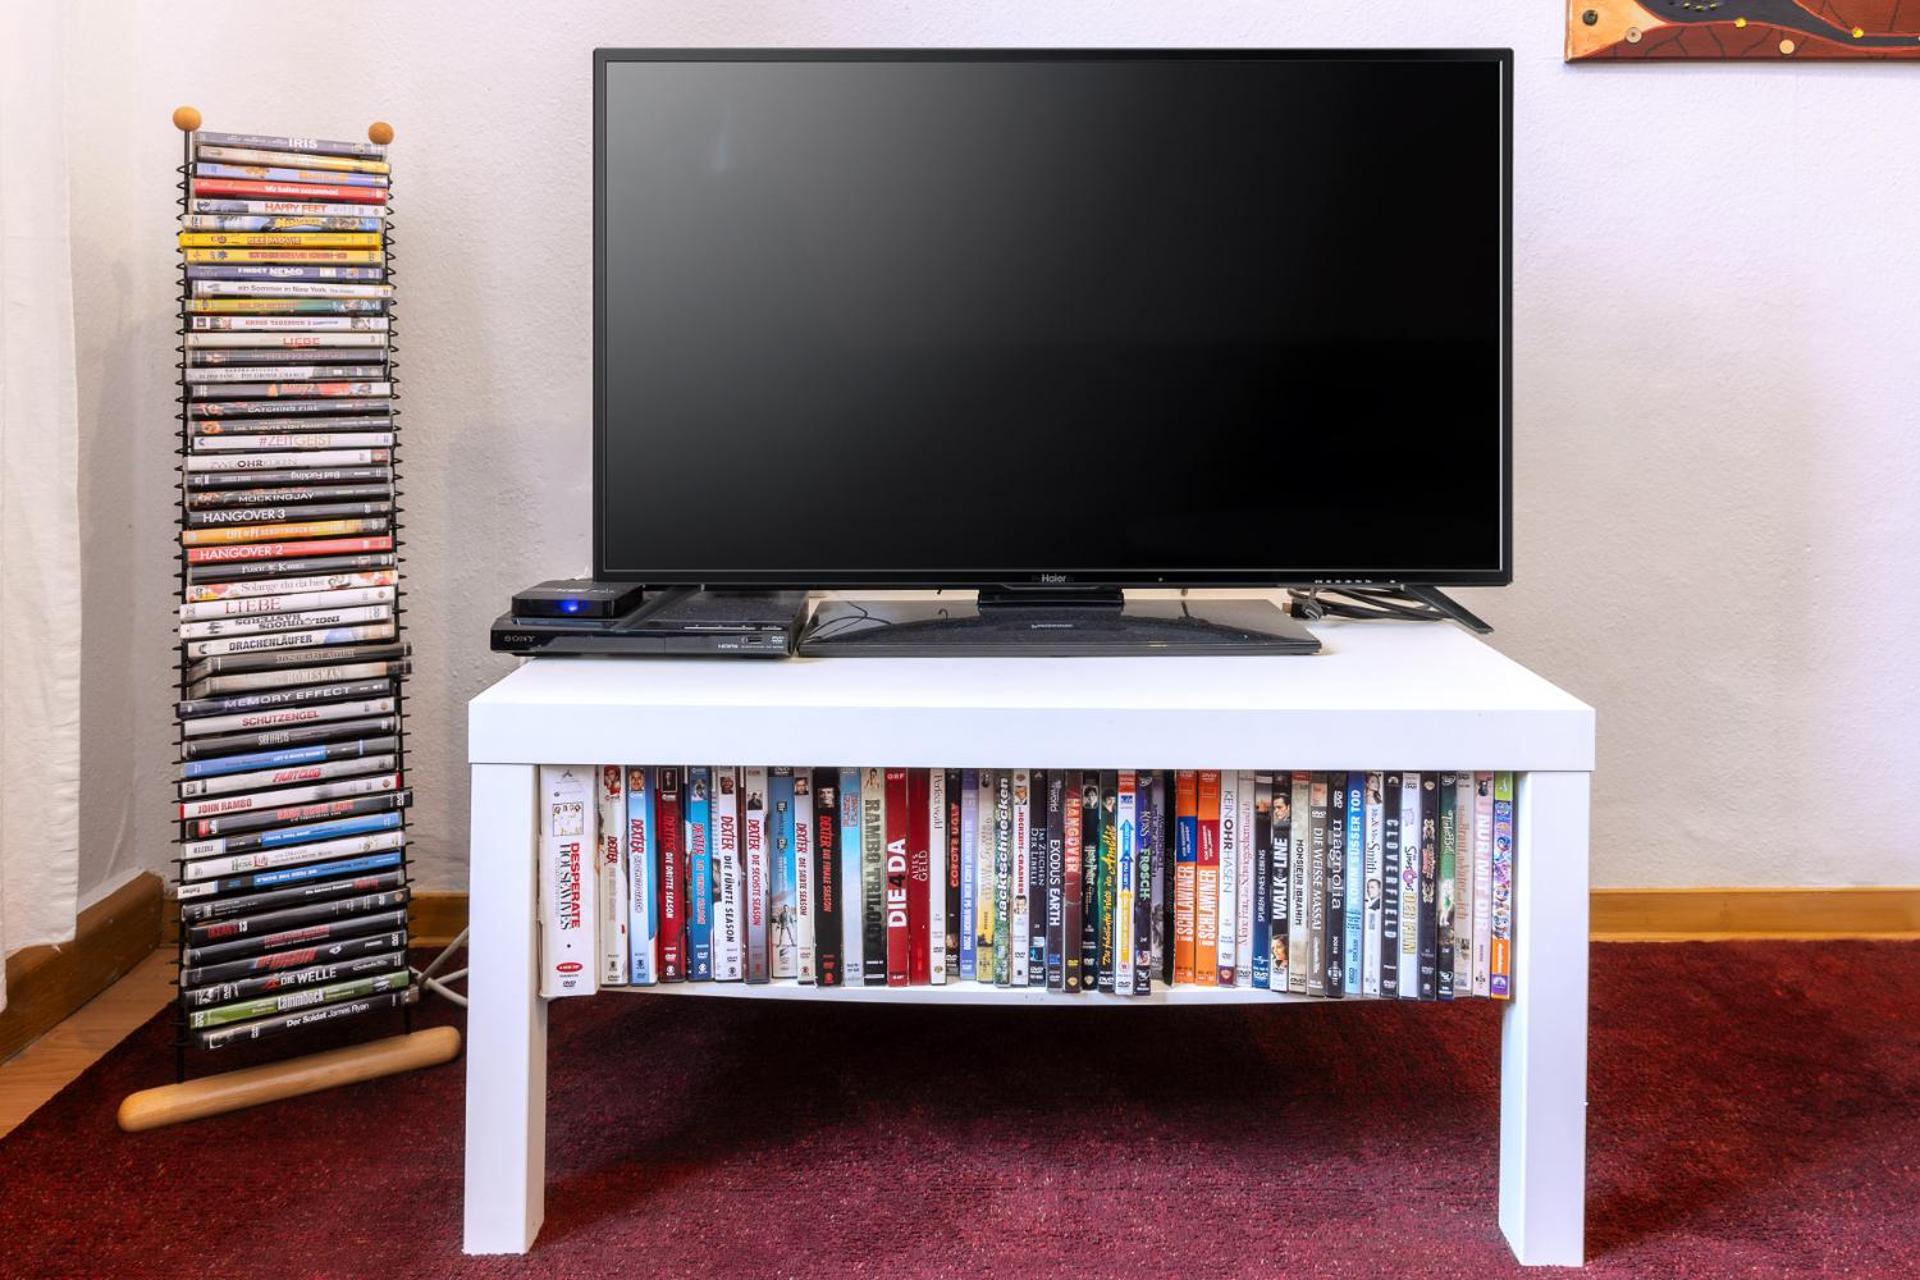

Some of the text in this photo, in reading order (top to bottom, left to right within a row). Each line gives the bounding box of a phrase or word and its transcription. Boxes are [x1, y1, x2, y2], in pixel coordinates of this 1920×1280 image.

[289, 138, 318, 149] IRIS
[265, 203, 327, 213] HAPPY FEET
[269, 268, 304, 276] NEMO
[283, 337, 320, 346] LIEBE
[259, 434, 332, 447] #ZEITGEIST
[238, 492, 314, 503] MOCKINGJAY
[203, 509, 285, 522] HANGOVER 3
[200, 546, 283, 560] HANGOVER 2
[241, 580, 279, 593] Solange
[1041, 573, 1066, 583] Haier
[225, 597, 281, 614] LIEBE
[287, 668, 342, 682] HOMESMAN
[224, 686, 351, 709] MEMORY EFFECT
[242, 710, 320, 726] SCHUTZENGEL
[198, 798, 252, 814] JOHN RAMBO
[630, 819, 646, 854] DEXTER
[692, 823, 705, 856] DEXTER
[796, 823, 810, 853] DEXTER
[819, 816, 834, 848] DEXTER
[950, 803, 958, 888] COYOTE UGLY
[1066, 798, 1079, 874] HANGOVER
[1223, 790, 1234, 893] KEINOHRHASEN
[1313, 828, 1323, 846] DIE
[608, 835, 618, 864] DEXTER
[665, 852, 674, 863] DIE
[998, 778, 1009, 922] nacktschnecken
[1258, 849, 1266, 874] LEBENS
[1329, 791, 1343, 909] DVD magnolia
[1350, 790, 1361, 905] KOMM TOD
[1366, 843, 1380, 874] Smith
[665, 865, 674, 889] DRITTE
[721, 816, 735, 943] DEXTER DIE FÜNFTE SEASON
[748, 819, 763, 926] DEXTER DIE SECHSTE SEASON
[823, 861, 831, 884] FINALE
[864, 799, 882, 945] RAMBO TRILOGY
[919, 851, 927, 882] GELD
[1139, 848, 1150, 898] FROSCH
[1272, 838, 1287, 920] WALK LINE
[1312, 847, 1323, 887] WEISSE
[1384, 819, 1398, 938] CLOVERFIELD
[1475, 815, 1490, 930] NUR MIT DIR
[560, 844, 571, 930] HOUSEWIVES
[571, 843, 580, 928] DESPERATE
[887, 838, 906, 928] DIE 4 DA
[1050, 839, 1061, 926] EXODUS EARTH
[665, 891, 674, 919] SEASON
[799, 891, 807, 916] SEASON
[823, 885, 832, 912] SEASON
[1177, 866, 1194, 935] SCHLAWINER
[1199, 870, 1216, 939] SCHLAWINER
[1295, 887, 1303, 925] IBRAHIM
[1312, 890, 1322, 930] MASSAI
[1403, 892, 1416, 919] DER
[238, 921, 248, 932] 13
[1403, 921, 1416, 955] FILM
[281, 968, 336, 985] DIE WELLE
[278, 989, 324, 1010] Lammbock
[286, 1003, 369, 1028] Der Soldat James Ryan
